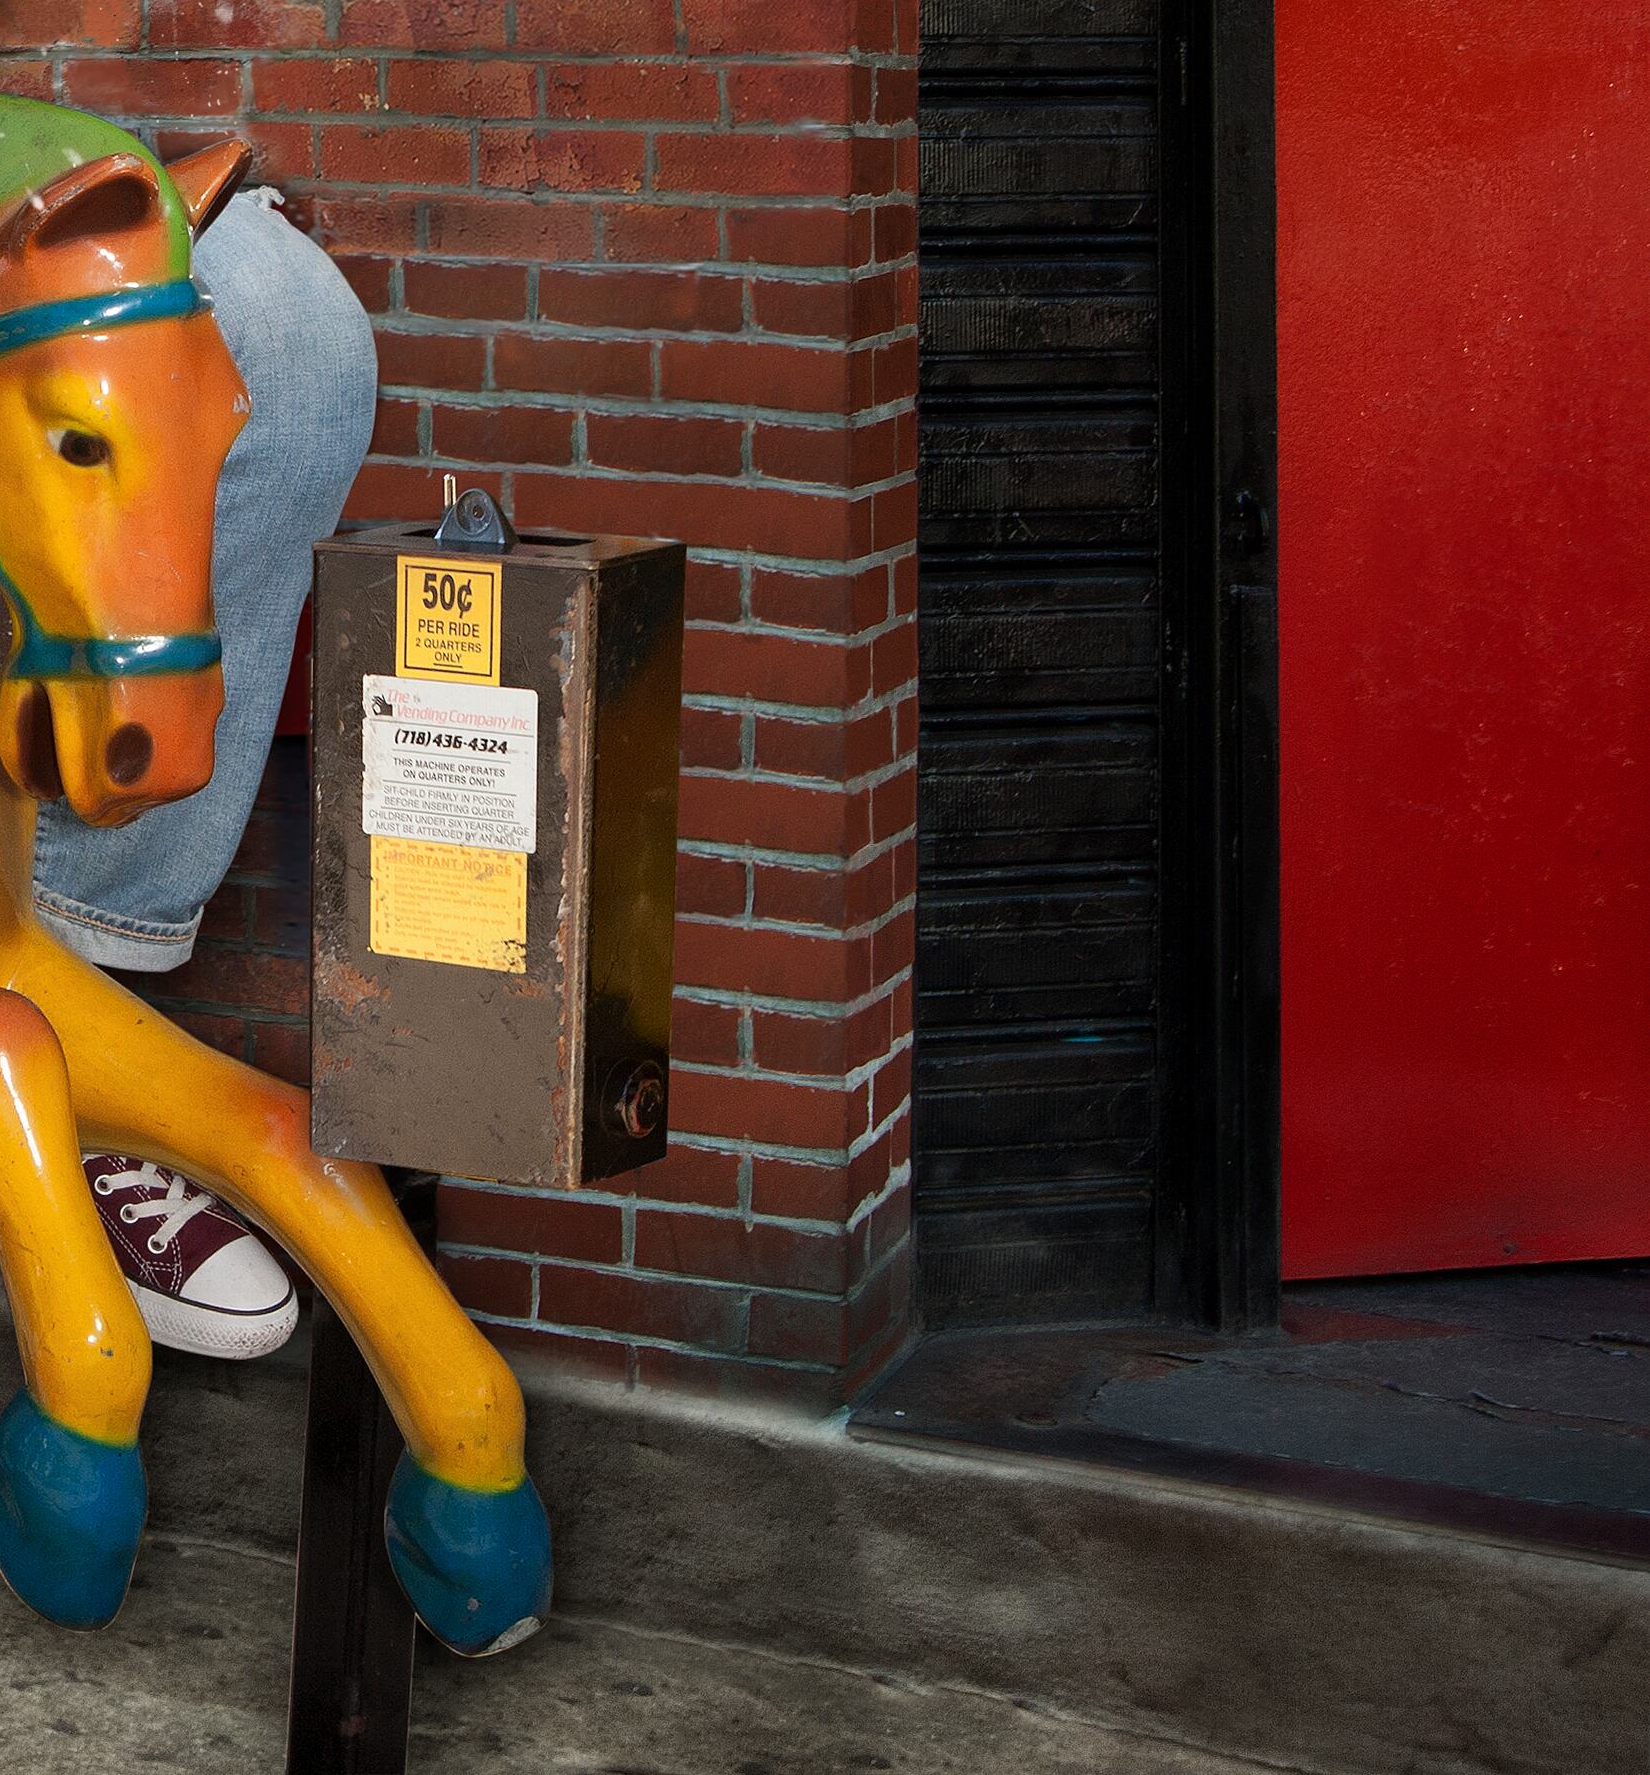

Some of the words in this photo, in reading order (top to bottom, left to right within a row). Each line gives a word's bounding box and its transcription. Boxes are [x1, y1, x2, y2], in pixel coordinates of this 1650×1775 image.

[423, 573, 472, 619] 50¢
[418, 619, 444, 635] PER
[449, 622, 480, 638] RIDE
[416, 637, 421, 648] 2
[424, 638, 482, 654] QUARTERS
[434, 651, 462, 663] ONLY
[388, 689, 410, 704] The
[397, 704, 447, 724] Vending
[449, 709, 511, 730] Company
[393, 757, 413, 768] THIS
[415, 759, 456, 773] MACHINE
[458, 764, 506, 778] OPERATES
[403, 769, 416, 779] ON
[418, 771, 467, 785] QUARTERS
[469, 776, 496, 788] ONLY!
[384, 796, 420, 809] BEFORE
[422, 800, 469, 815] INSERTING
[471, 805, 515, 819] QUARTER
[428, 789, 458, 802] FIRMLY
[461, 793, 469, 803] IN
[472, 794, 516, 809] POSITION
[369, 809, 412, 823] CHILDREN
[415, 813, 447, 827] UNDER
[449, 818, 464, 829] SIX
[463, 819, 494, 832] YEARS
[496, 823, 508, 834] OF
[511, 825, 530, 837] AGE
[376, 822, 400, 833] MUST
[403, 825, 414, 835] BE
[416, 826, 463, 841] ATTENDED
[465, 831, 476, 842] BY
[480, 833, 492, 843] AN
[494, 834, 522, 848] ADULT
[383, 851, 457, 869] IMPORTANT
[464, 859, 512, 877] NOTICE
